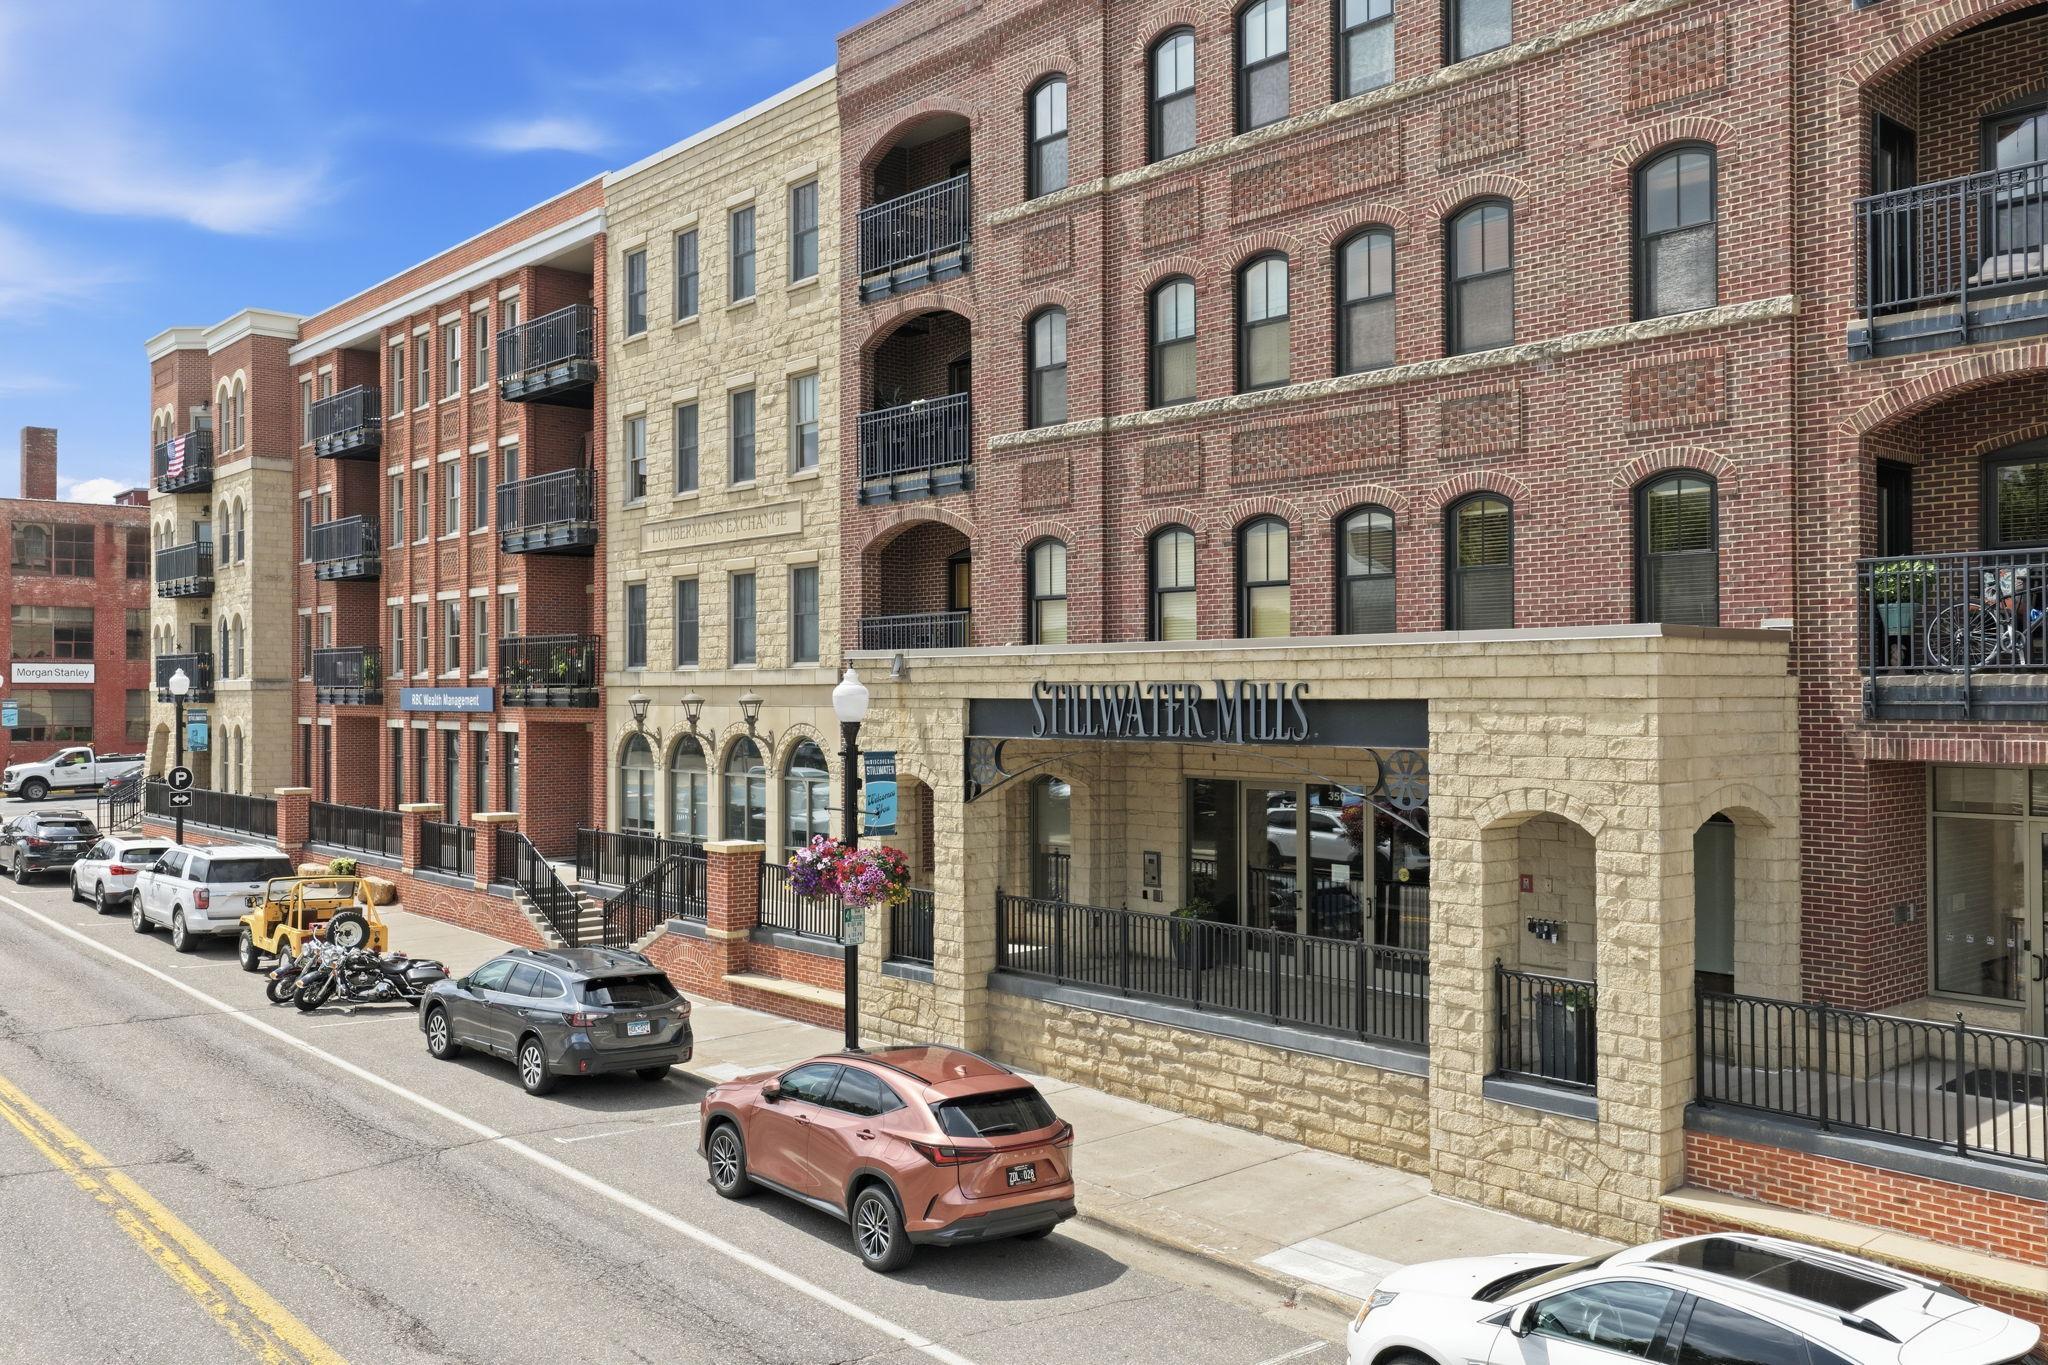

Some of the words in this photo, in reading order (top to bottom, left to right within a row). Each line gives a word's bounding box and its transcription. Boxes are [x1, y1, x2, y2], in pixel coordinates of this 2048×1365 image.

[726, 510, 787, 534] EXCHANGE
[16, 668, 53, 678] Morgan
[54, 668, 90, 679] Stanley
[411, 694, 422, 705] RBC
[423, 693, 441, 706] Wealth
[443, 693, 479, 708] Management
[1031, 681, 1208, 738] STILLWATER
[1214, 679, 1310, 744] MILLS
[866, 766, 895, 776] STILLWATER
[175, 772, 188, 786] P
[1328, 791, 1344, 801] 350
[1008, 1172, 1020, 1182] ZDL
